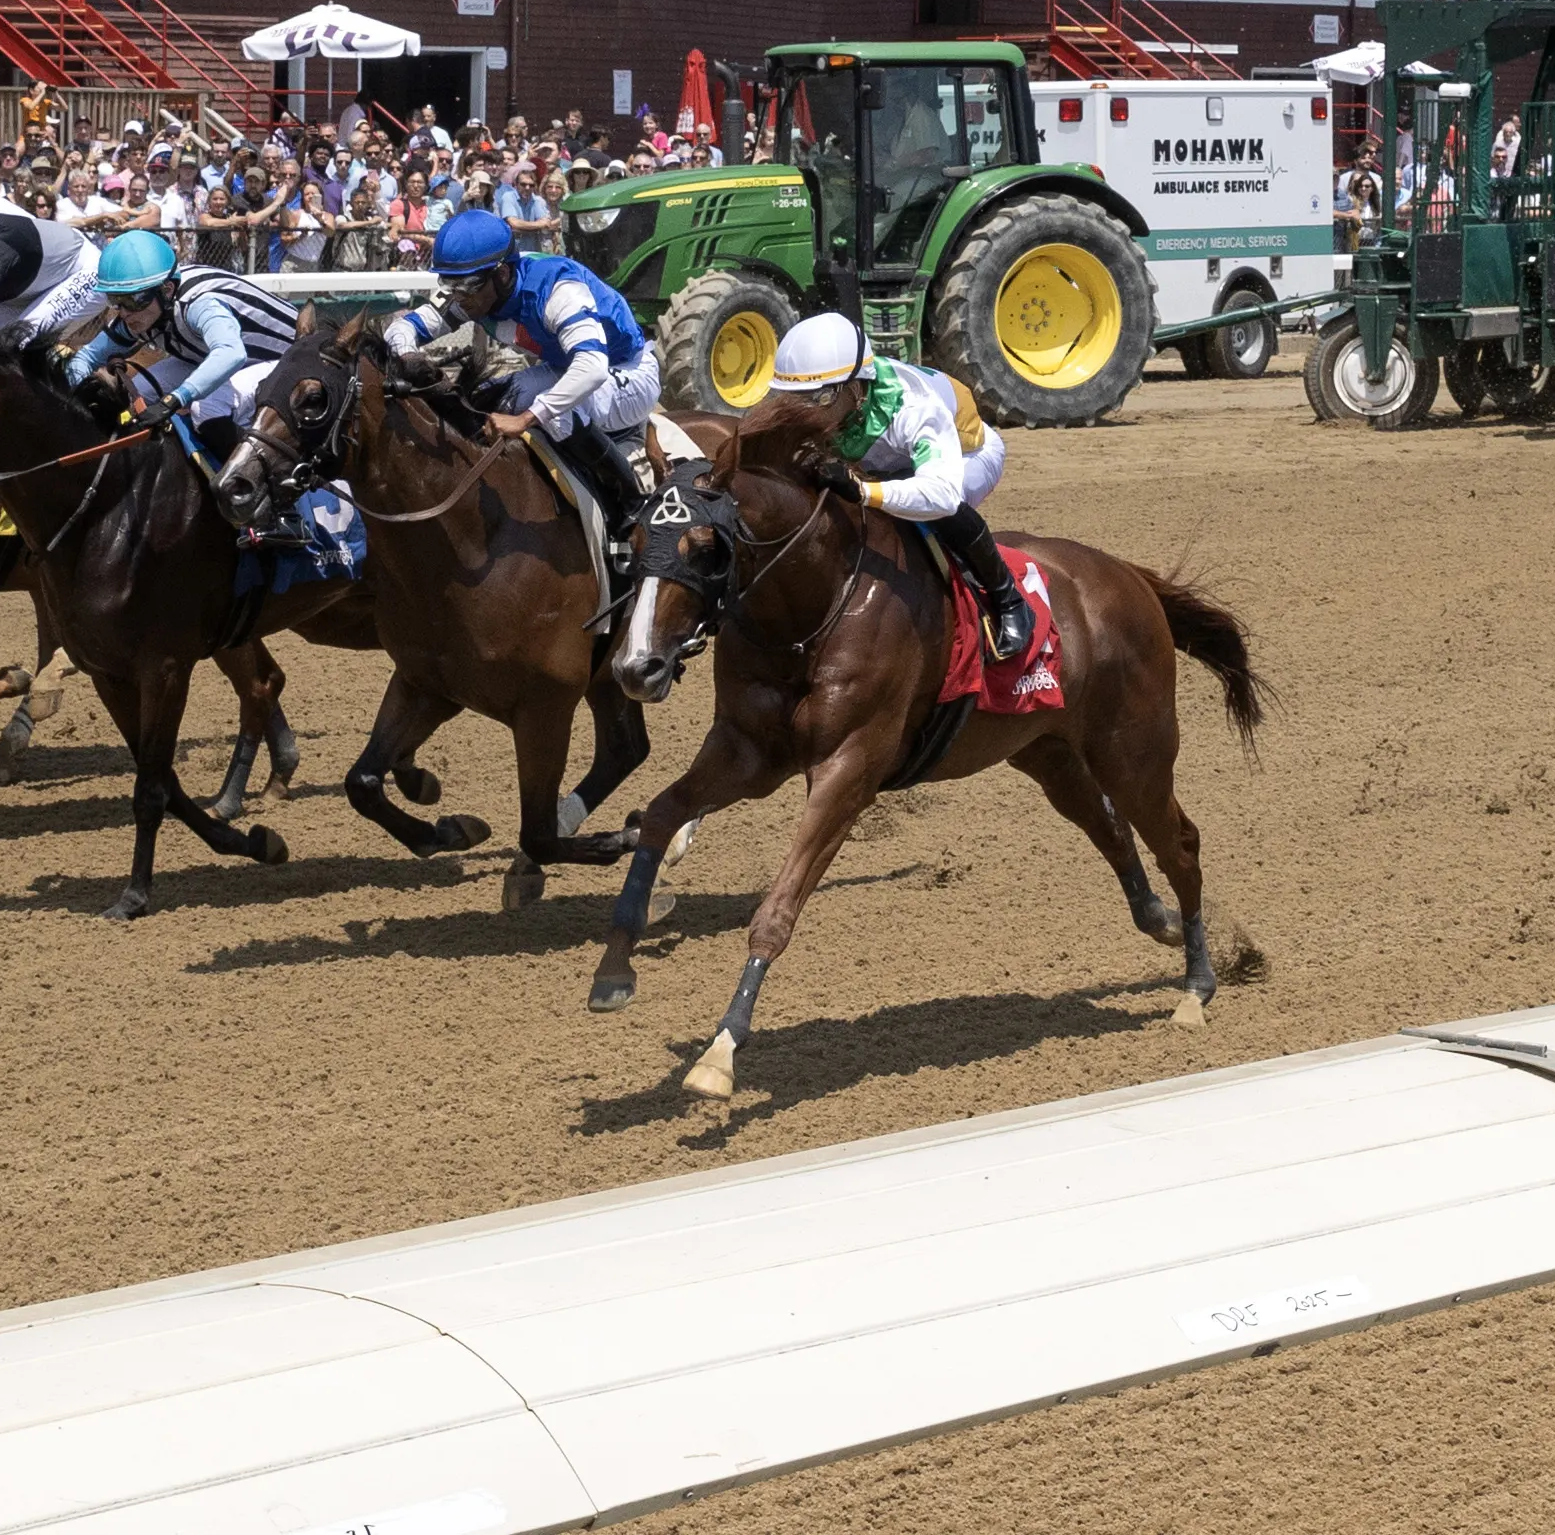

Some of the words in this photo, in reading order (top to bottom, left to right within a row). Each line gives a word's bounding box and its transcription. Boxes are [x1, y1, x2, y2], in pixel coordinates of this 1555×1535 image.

[1152, 138, 1264, 165] MOHAWK
[735, 180, 754, 188] JOHN
[1153, 180, 1220, 195] AMBULANCE
[1223, 179, 1269, 193] SERVICE
[1156, 237, 1208, 251] EMERGENCY
[1209, 236, 1246, 249] MEDICAL
[1247, 234, 1288, 248] SERVICES
[47, 293, 67, 309] THE
[1211, 1303, 1258, 1332] DRF
